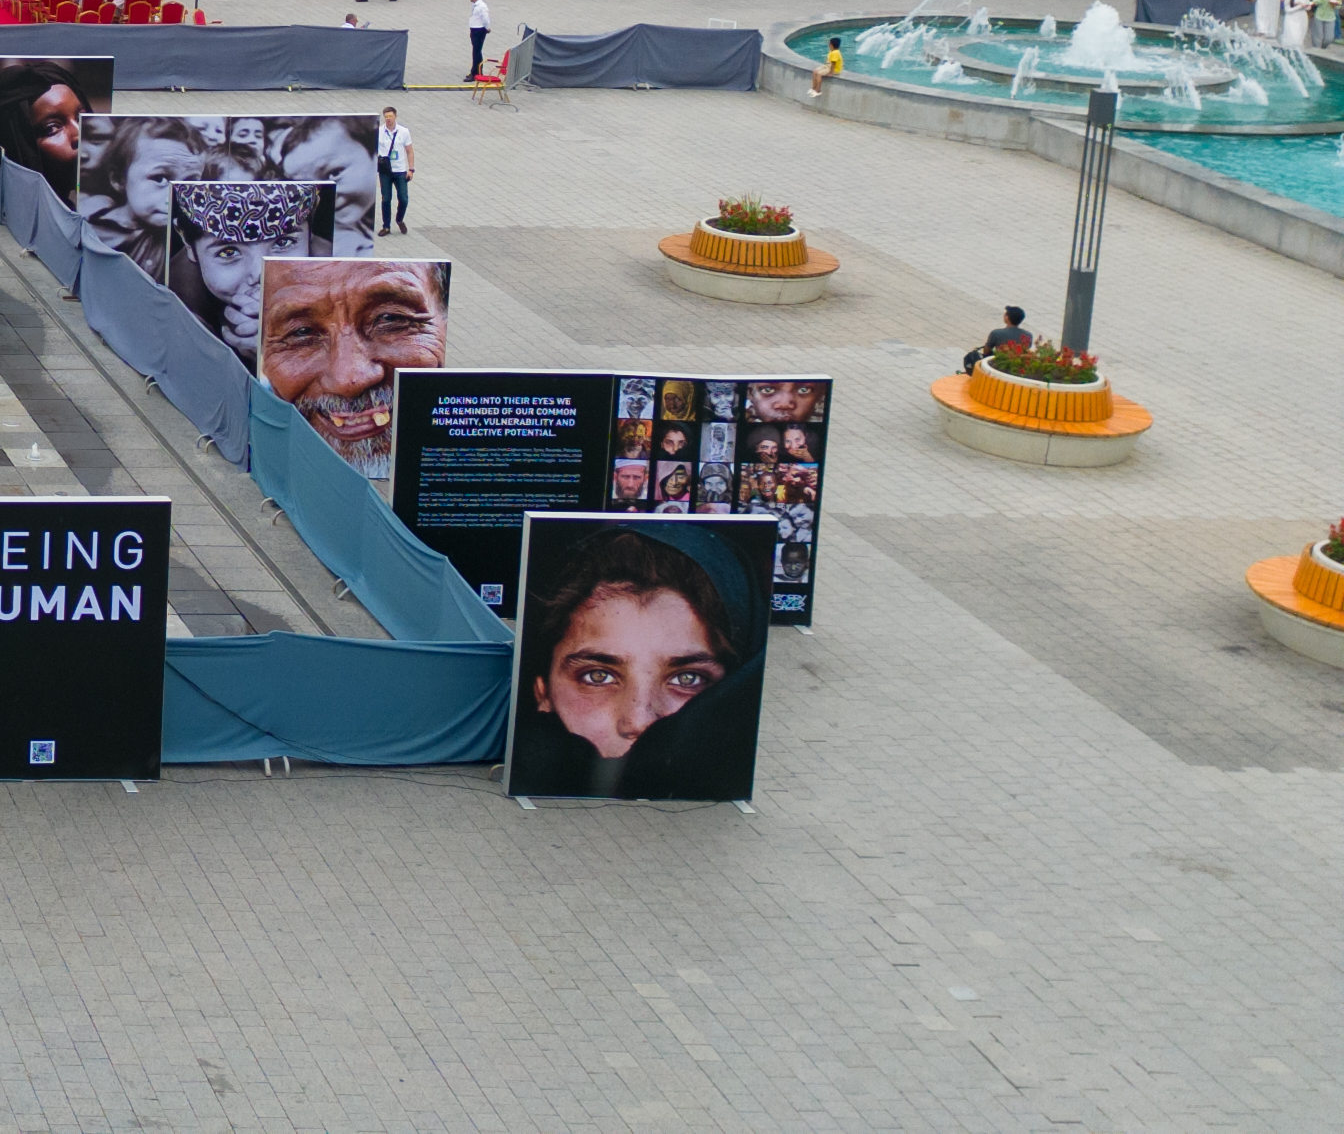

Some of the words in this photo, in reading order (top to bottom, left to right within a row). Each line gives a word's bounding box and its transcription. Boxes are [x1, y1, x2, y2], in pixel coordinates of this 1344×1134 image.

[438, 396, 478, 404] LOOKING
[480, 396, 501, 404] INTO
[503, 397, 530, 405] THEIR
[532, 397, 554, 405] EYES
[452, 408, 500, 416] REMINDED
[502, 408, 514, 416] OF
[516, 408, 534, 416] OUR
[536, 408, 576, 416] COMMON
[432, 418, 482, 426] HUMANITY,
[484, 418, 554, 426] VULNERABILITY
[449, 428, 502, 436] COLLECTIVE
